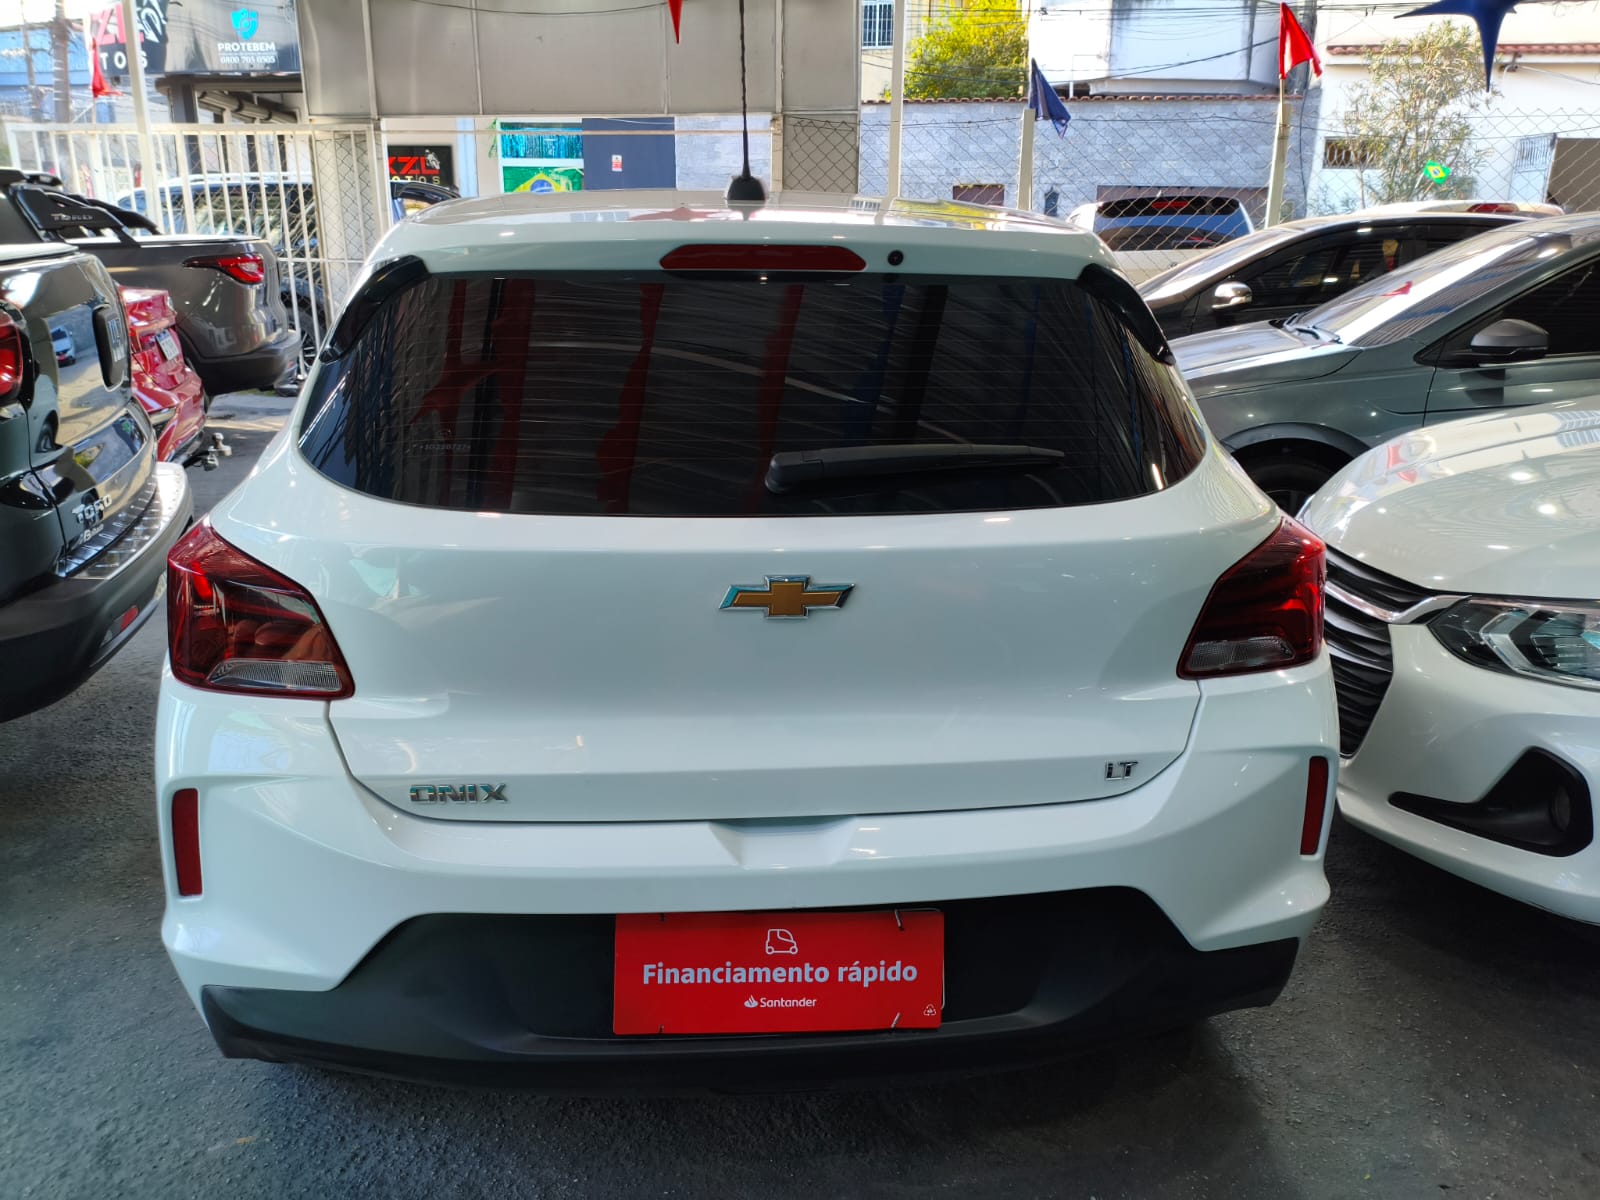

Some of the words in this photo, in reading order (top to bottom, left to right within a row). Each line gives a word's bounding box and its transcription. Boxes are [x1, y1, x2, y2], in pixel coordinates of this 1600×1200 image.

[217, 42, 276, 52] PROTEBEM
[72, 494, 112, 524] TORO
[1106, 761, 1138, 781] LT
[410, 783, 507, 804] ONIX
[642, 961, 830, 985] Financiamento
[837, 960, 918, 988] rápido
[759, 997, 817, 1008] Santander
